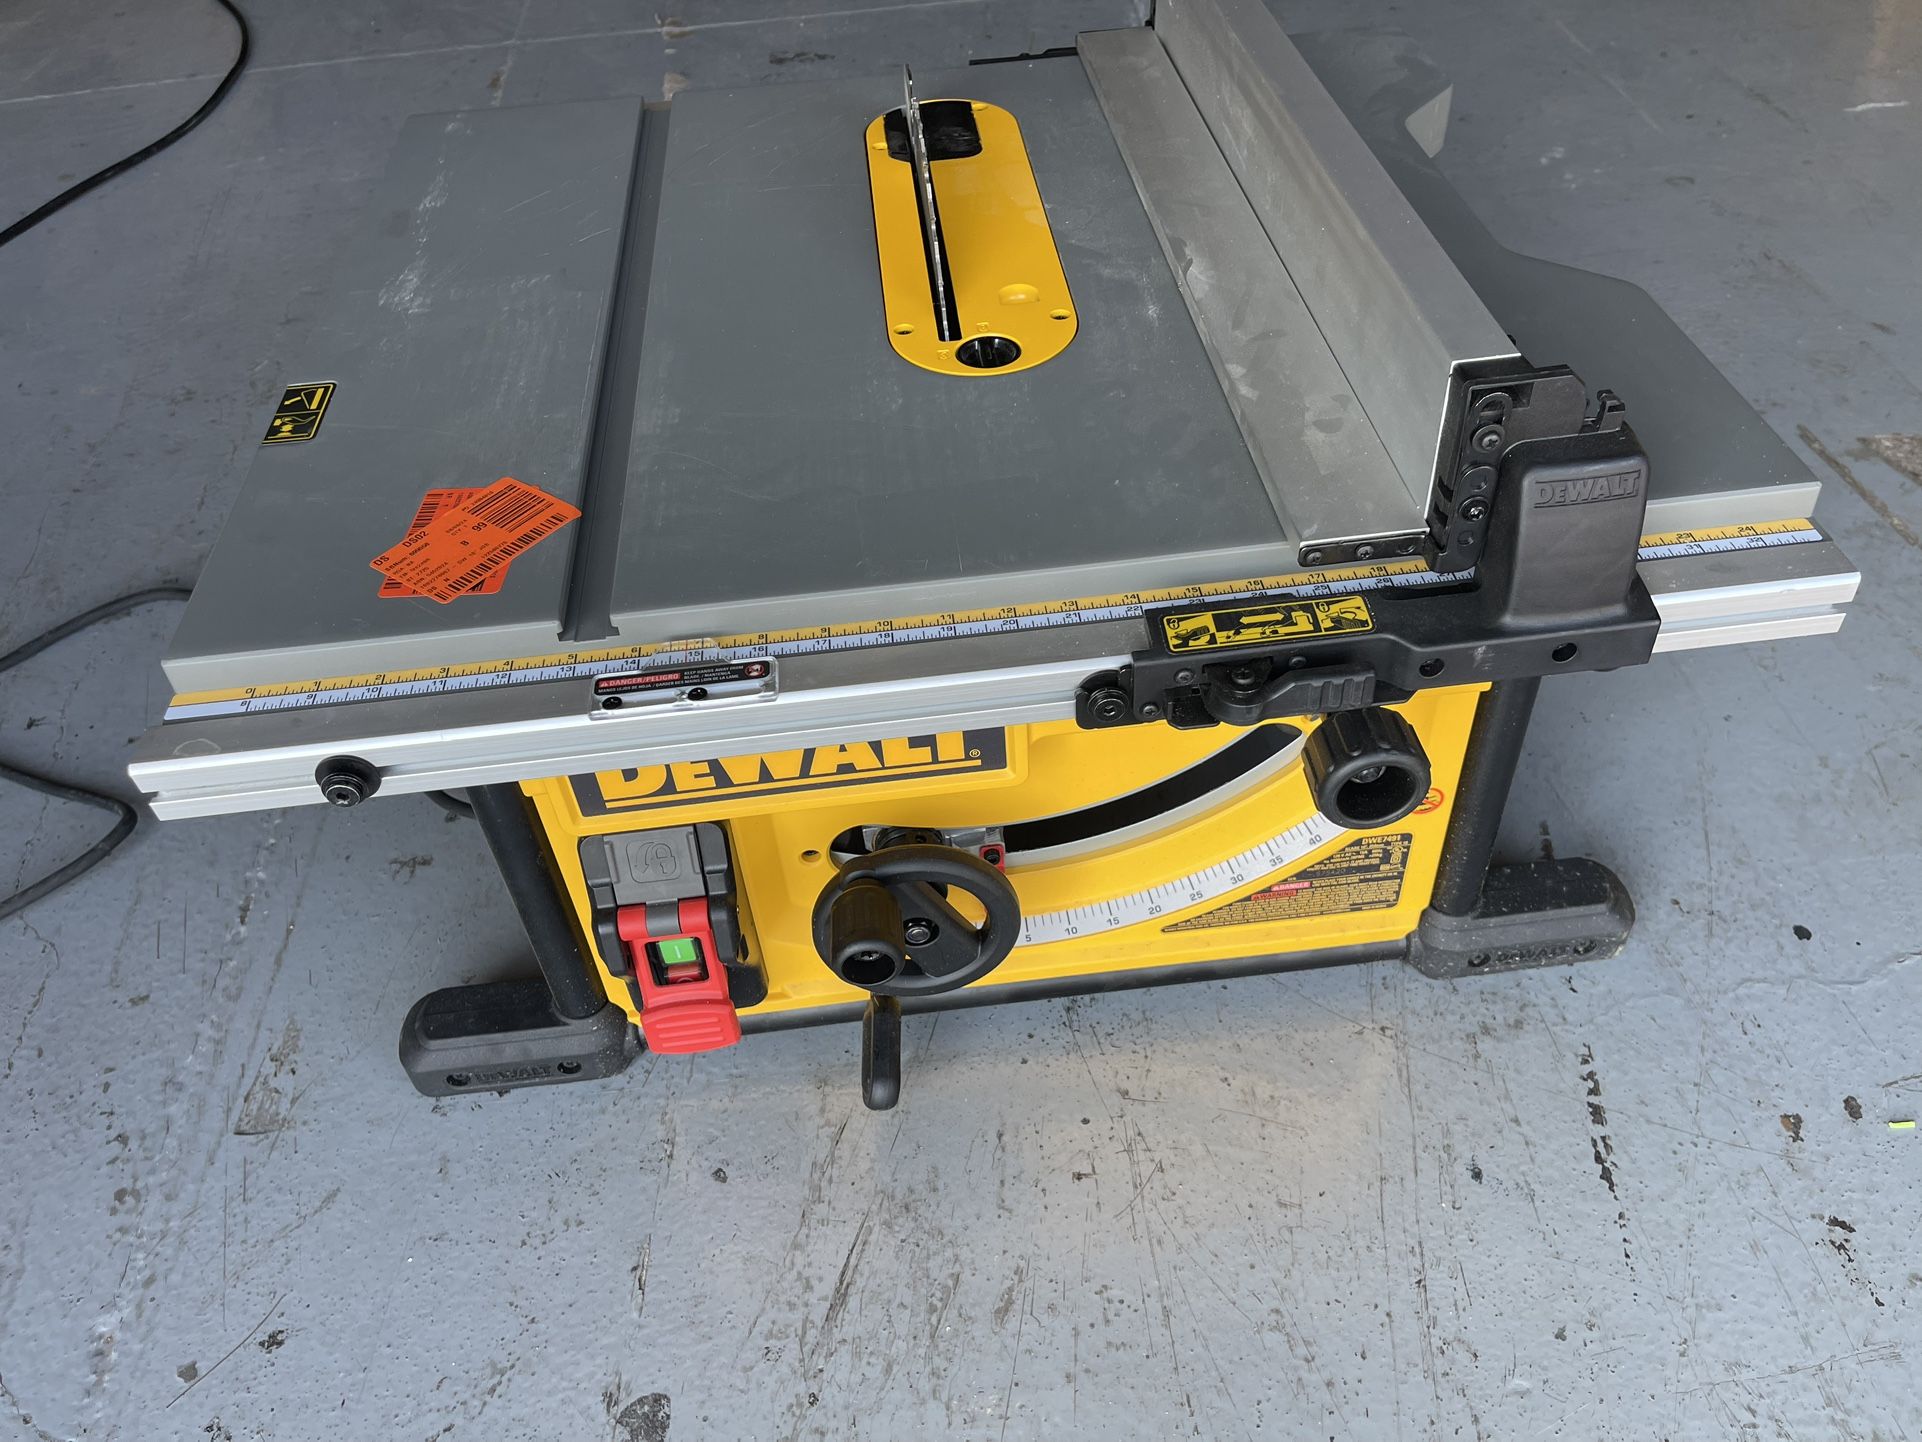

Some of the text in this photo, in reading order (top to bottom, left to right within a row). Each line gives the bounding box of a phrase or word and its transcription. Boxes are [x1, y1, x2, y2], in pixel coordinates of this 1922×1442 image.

[1534, 473, 1640, 505] DEWALT
[471, 521, 488, 532] 99
[373, 530, 429, 566] DS DS02
[609, 673, 679, 687] DANGER/PELIGRO
[1361, 834, 1401, 845] DWE7491
[1025, 834, 1323, 942] 5 10 15 20 25 30 35 40
